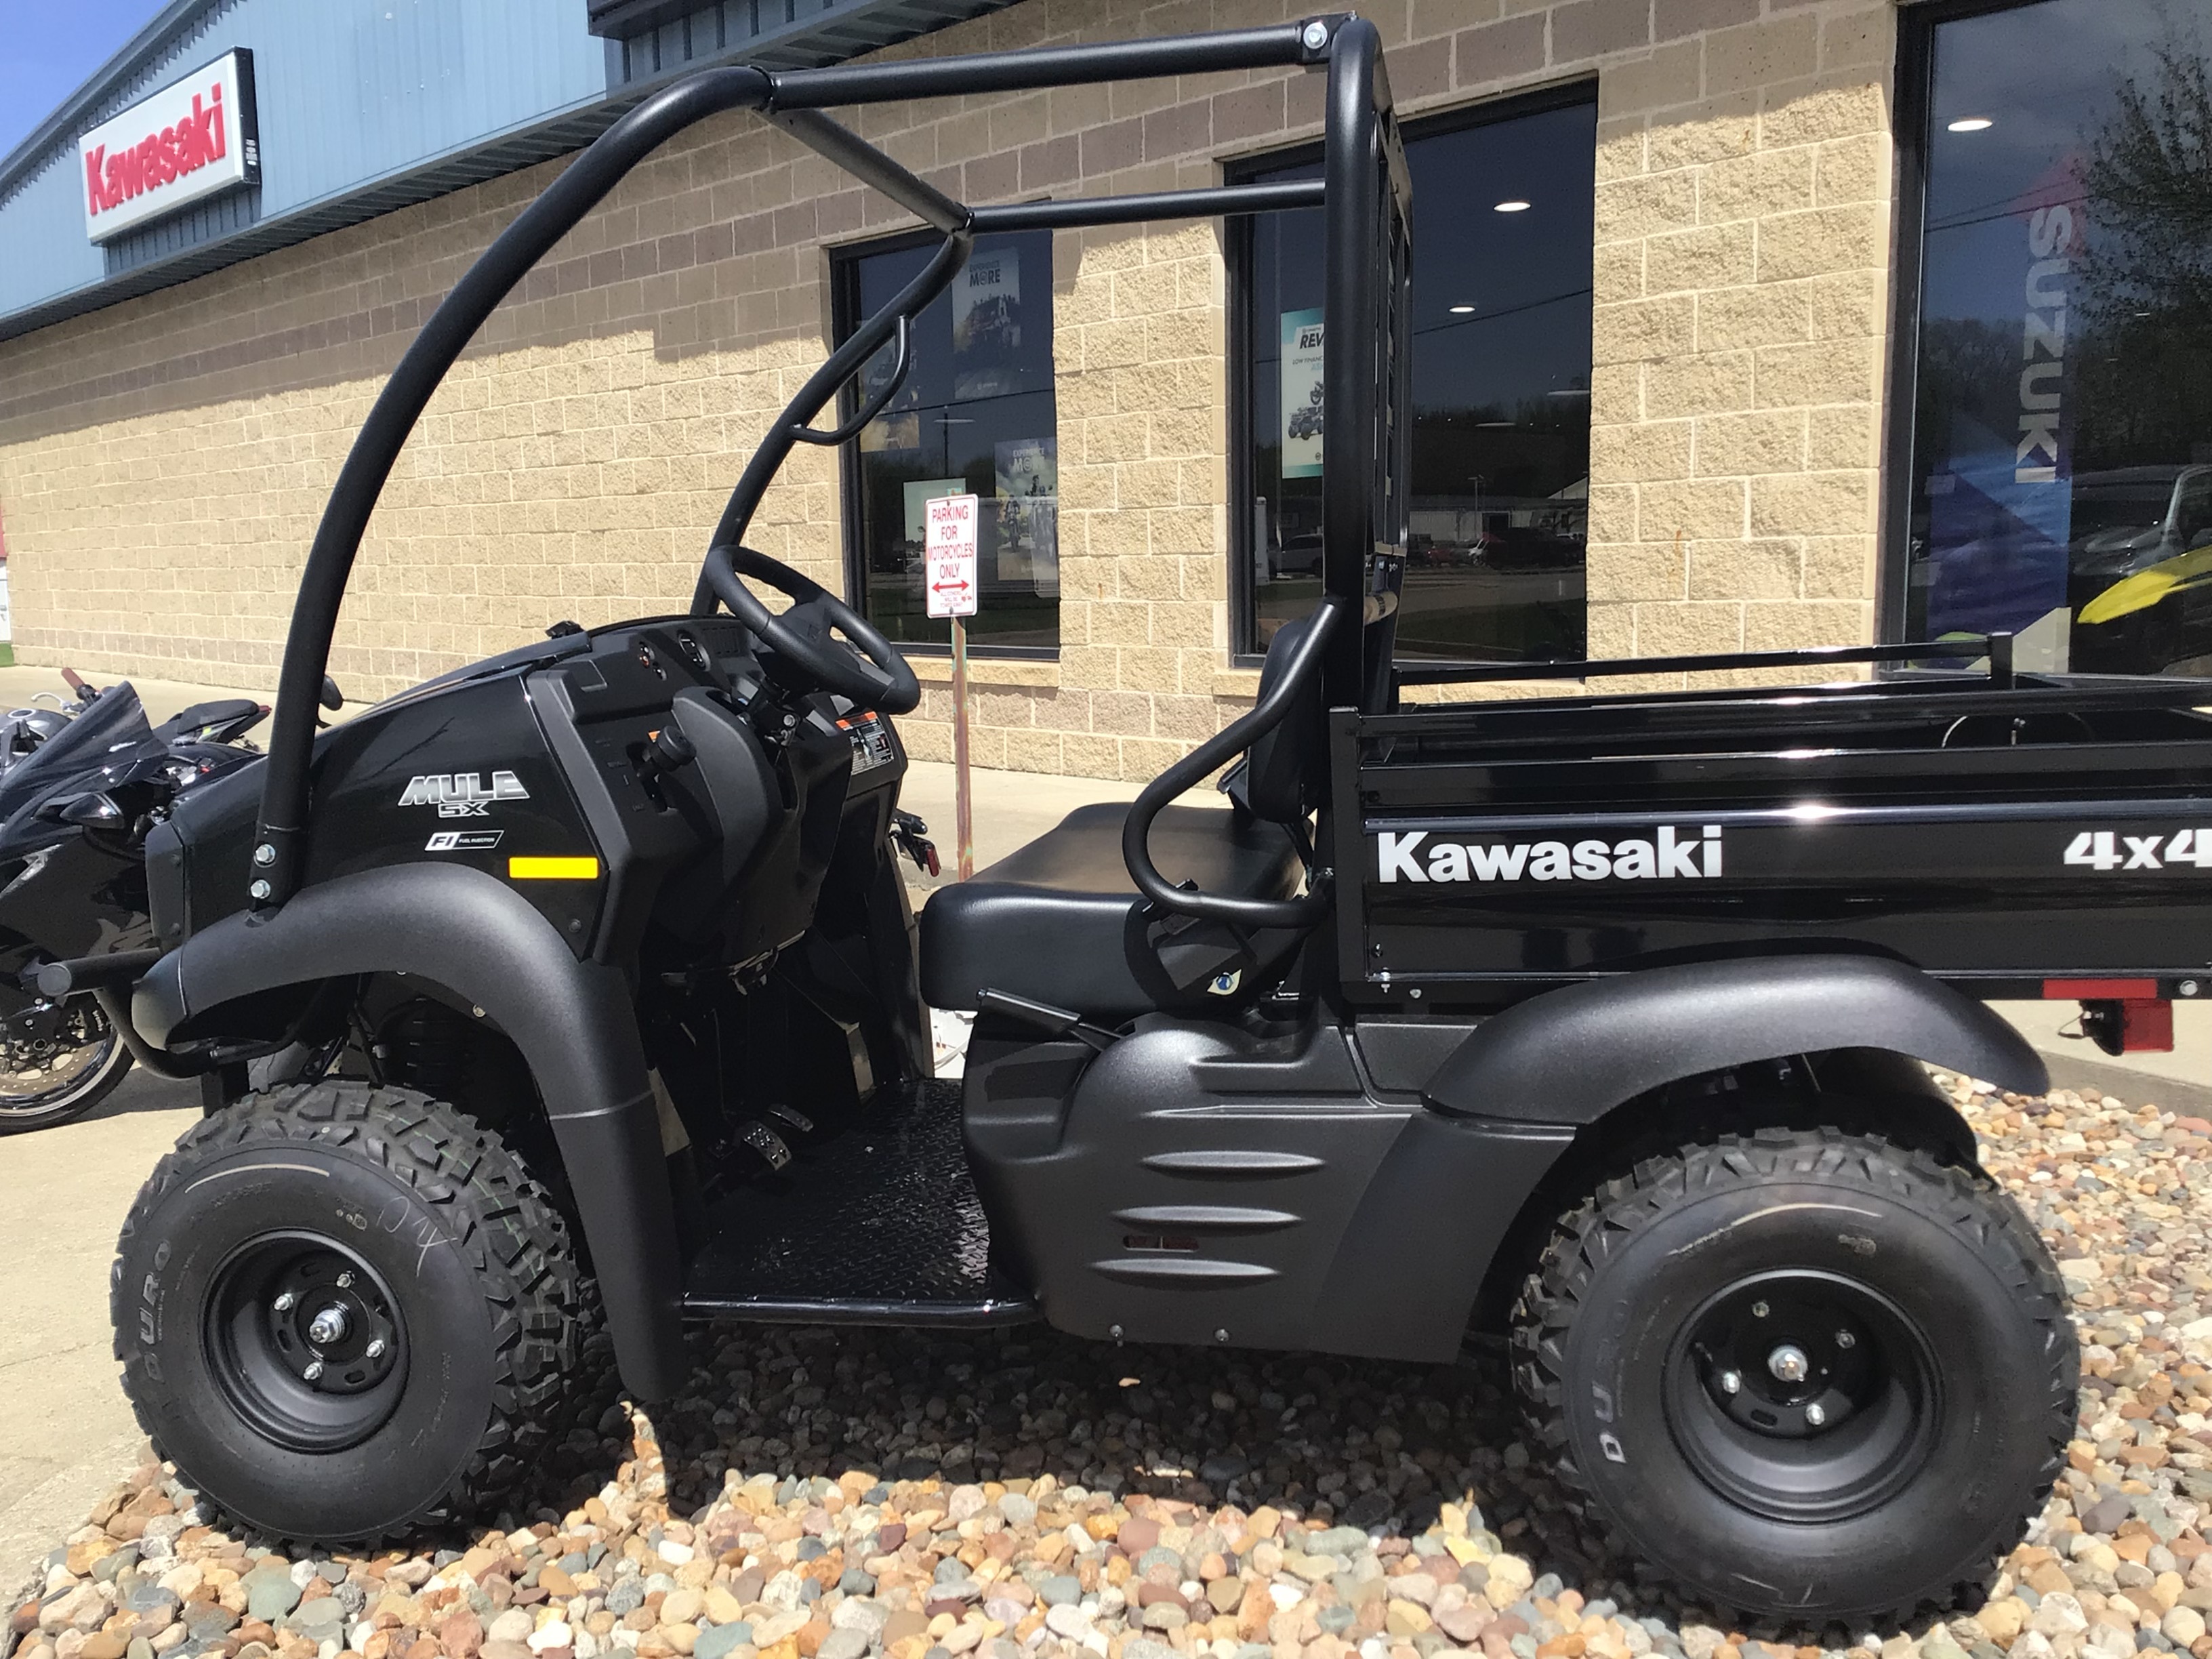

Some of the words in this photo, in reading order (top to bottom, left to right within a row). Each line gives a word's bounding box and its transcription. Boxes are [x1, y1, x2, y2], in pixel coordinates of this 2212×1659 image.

[85, 81, 226, 216] Kawasaki
[2015, 205, 2073, 484] SUZUKI
[932, 504, 969, 523] PARKING
[941, 525, 958, 541] FOR
[928, 542, 973, 562] MOTORCYCLES
[939, 562, 960, 579] ONLY
[398, 771, 531, 806] MULE
[438, 801, 491, 819] SX
[431, 836, 455, 846] FI
[2063, 828, 2212, 871] 4x4
[1377, 825, 1723, 883] Kawasaki
